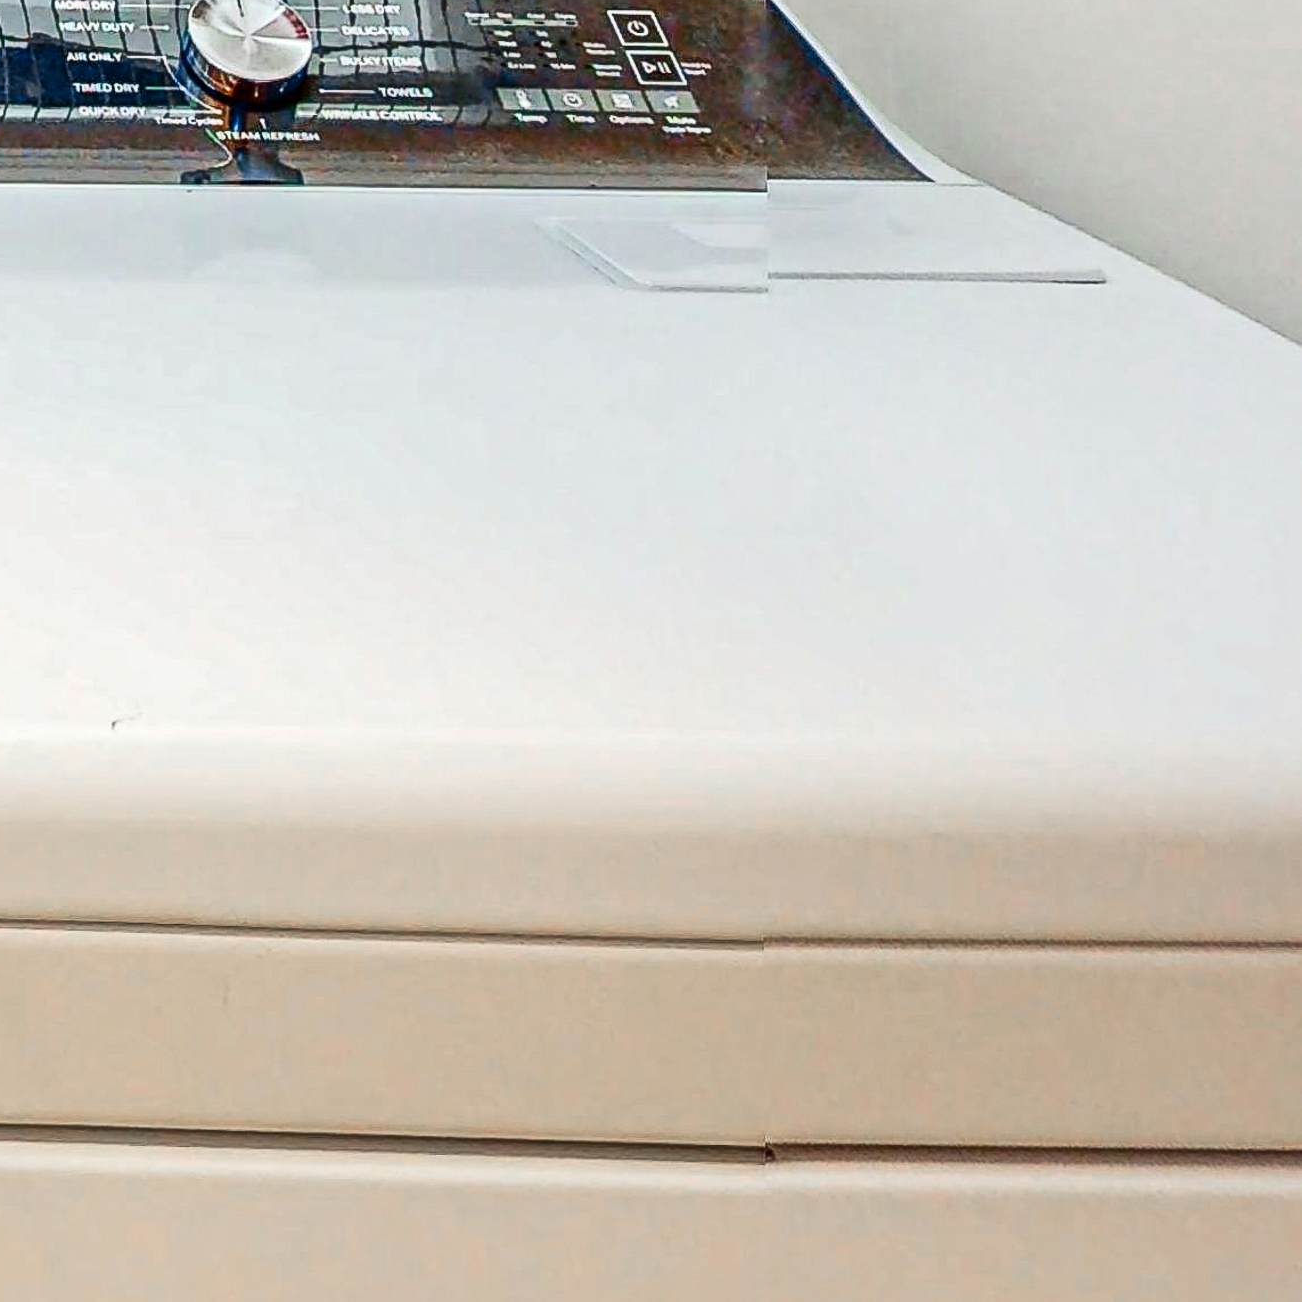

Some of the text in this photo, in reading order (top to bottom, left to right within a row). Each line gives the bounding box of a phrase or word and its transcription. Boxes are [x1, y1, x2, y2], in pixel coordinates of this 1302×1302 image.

[91, 0, 116, 11] DRY
[60, 22, 134, 32] HEAVY DUTY
[341, 26, 410, 36] DELICATES
[66, 52, 123, 62] AIR ONLY
[114, 83, 140, 93] DRY
[378, 87, 433, 98] TOWELS
[121, 106, 147, 118] DRY
[216, 131, 261, 142] STEAM
